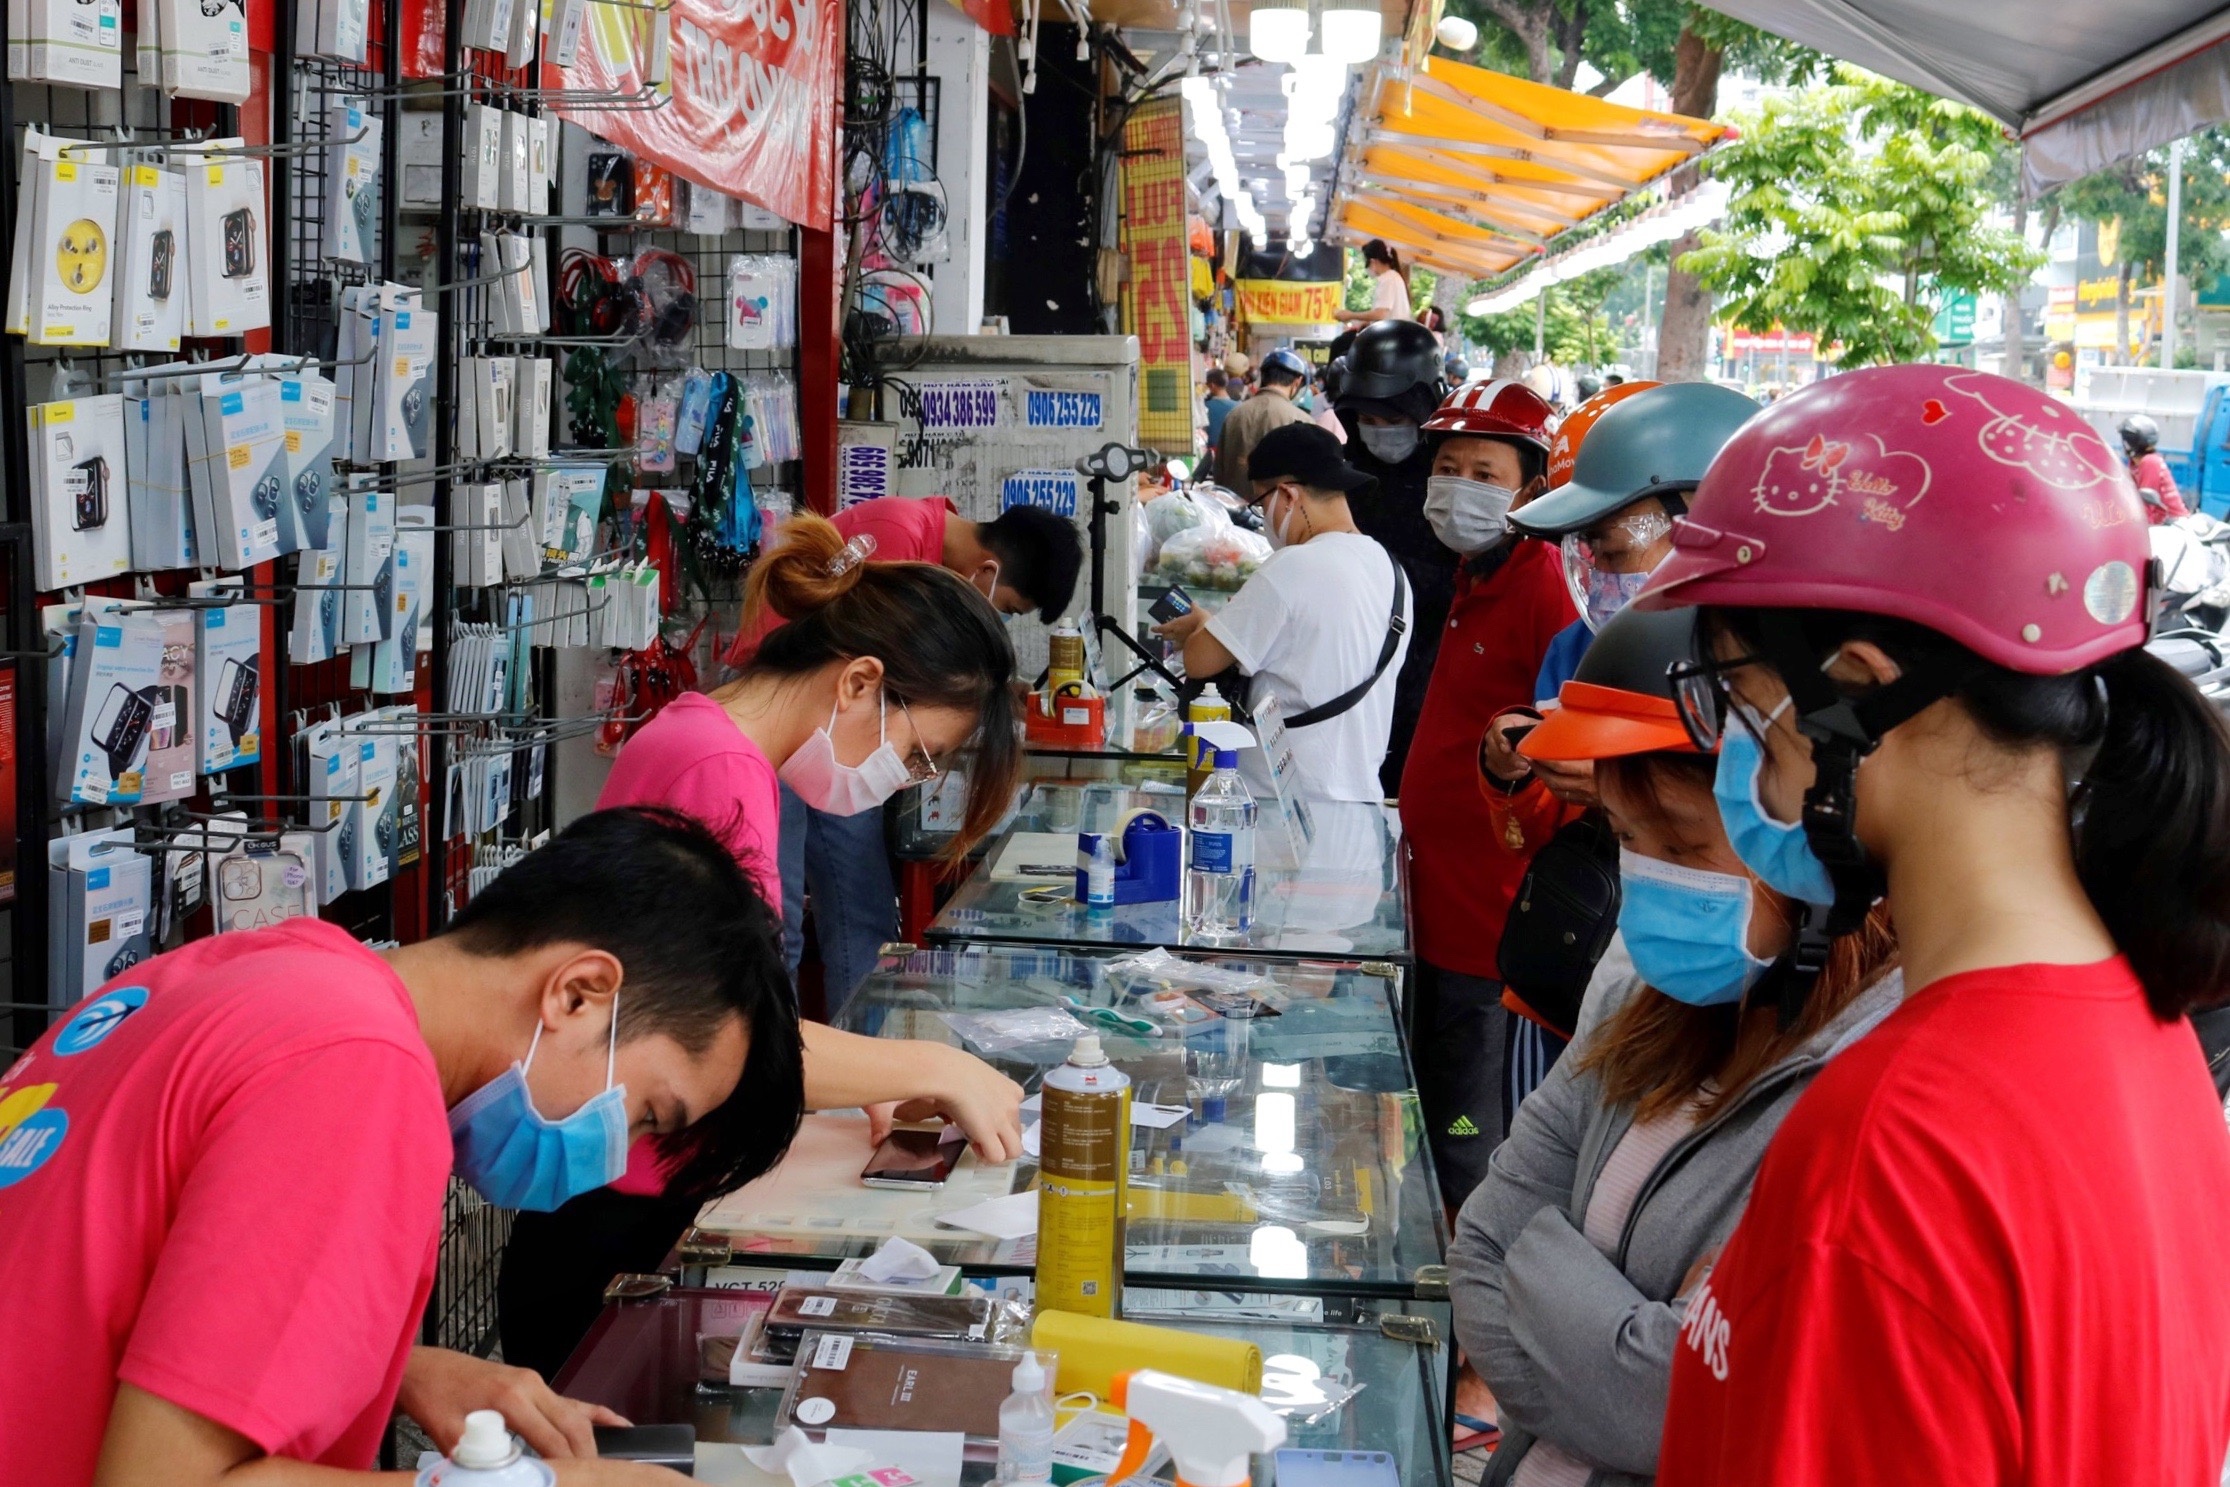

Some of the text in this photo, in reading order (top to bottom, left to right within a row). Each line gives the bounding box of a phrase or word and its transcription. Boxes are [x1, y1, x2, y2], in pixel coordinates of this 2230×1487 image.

[1862, 497, 1906, 531] Kitty
[1448, 1126, 1480, 1136] adidas
[1330, 1309, 1342, 1317] life
[1680, 1273, 1731, 1381] ANS
[902, 1369, 918, 1391] EARL
